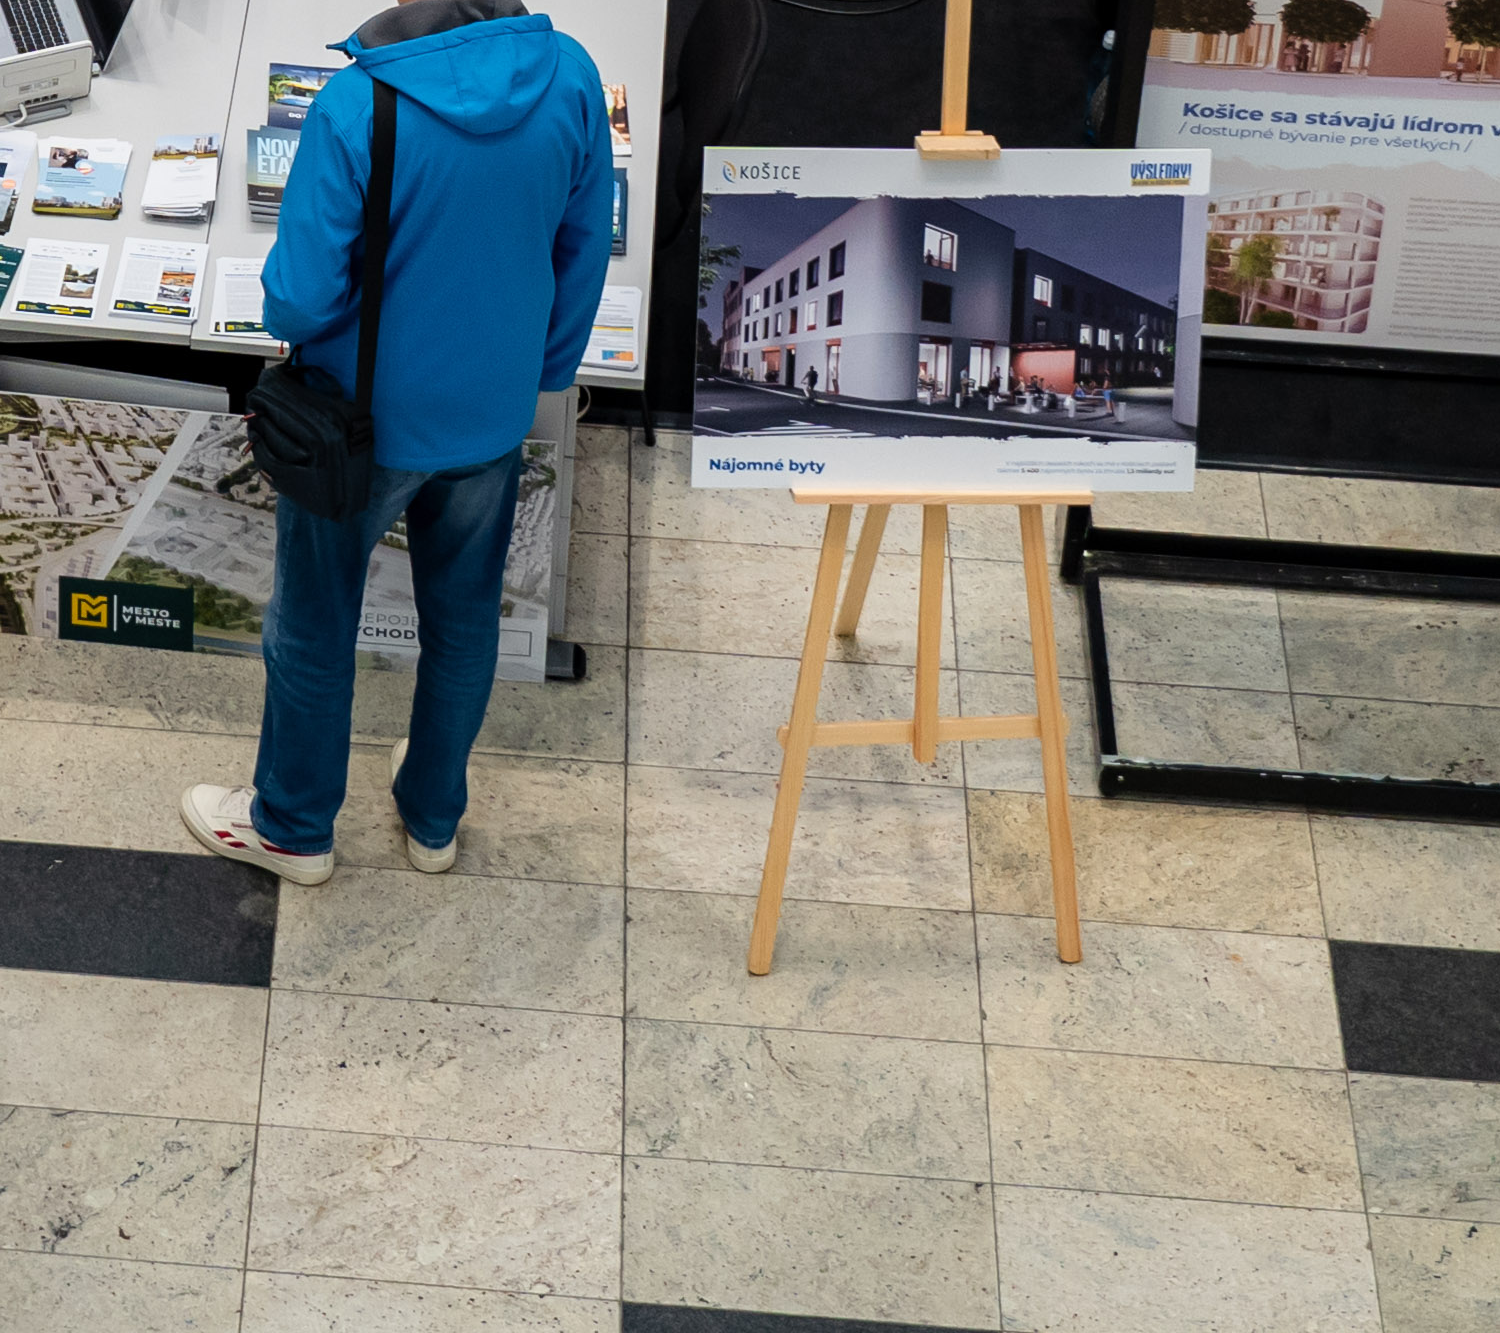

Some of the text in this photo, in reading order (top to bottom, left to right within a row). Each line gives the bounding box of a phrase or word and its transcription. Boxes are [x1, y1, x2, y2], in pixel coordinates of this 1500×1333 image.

[1183, 102, 1264, 122] Košice
[1270, 110, 1297, 124] sa
[1304, 110, 1395, 132] stávajú
[1403, 116, 1483, 136] lídrom
[1190, 124, 1274, 140] dostupné
[1279, 127, 1345, 145] bývanie
[1350, 134, 1380, 148] pre
[1384, 136, 1460, 152] všetkých
[740, 162, 801, 180] KOŠICE
[1130, 162, 1193, 180] VÝSLEDKY!
[708, 457, 825, 475] Nájomné byty
[121, 604, 170, 619] MESTO
[122, 614, 181, 629] V MESTE
